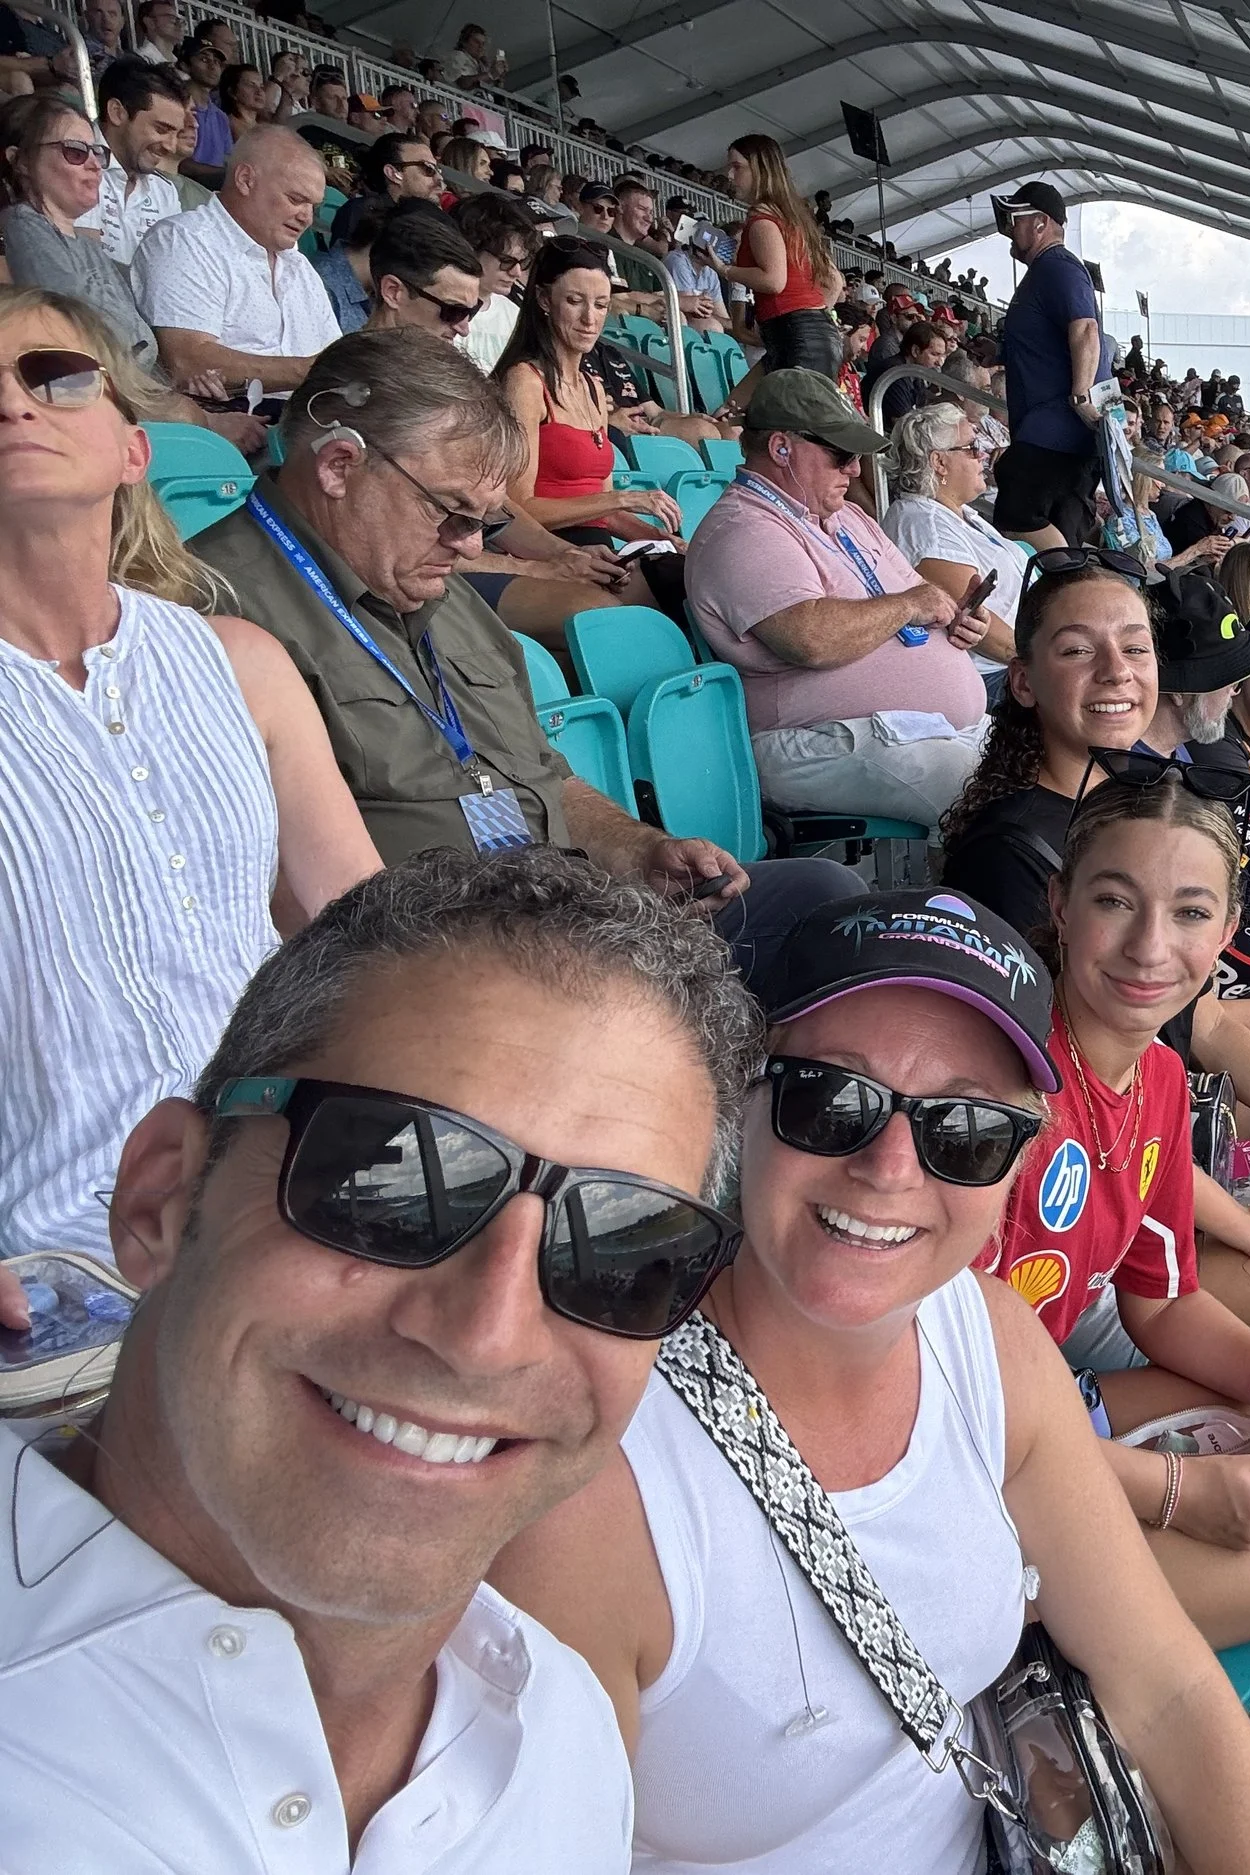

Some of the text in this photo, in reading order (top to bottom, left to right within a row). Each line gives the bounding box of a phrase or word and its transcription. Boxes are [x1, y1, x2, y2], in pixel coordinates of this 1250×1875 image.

[747, 479, 777, 506] EXPRESS
[266, 517, 296, 551] EXPRESS
[304, 566, 369, 643] AMERICAN EXPRESS
[865, 919, 1015, 972] MIAMI
[891, 913, 983, 938] FORMULA
[877, 932, 1010, 978] GRAND PRIX
[1044, 1142, 1085, 1230] hp
